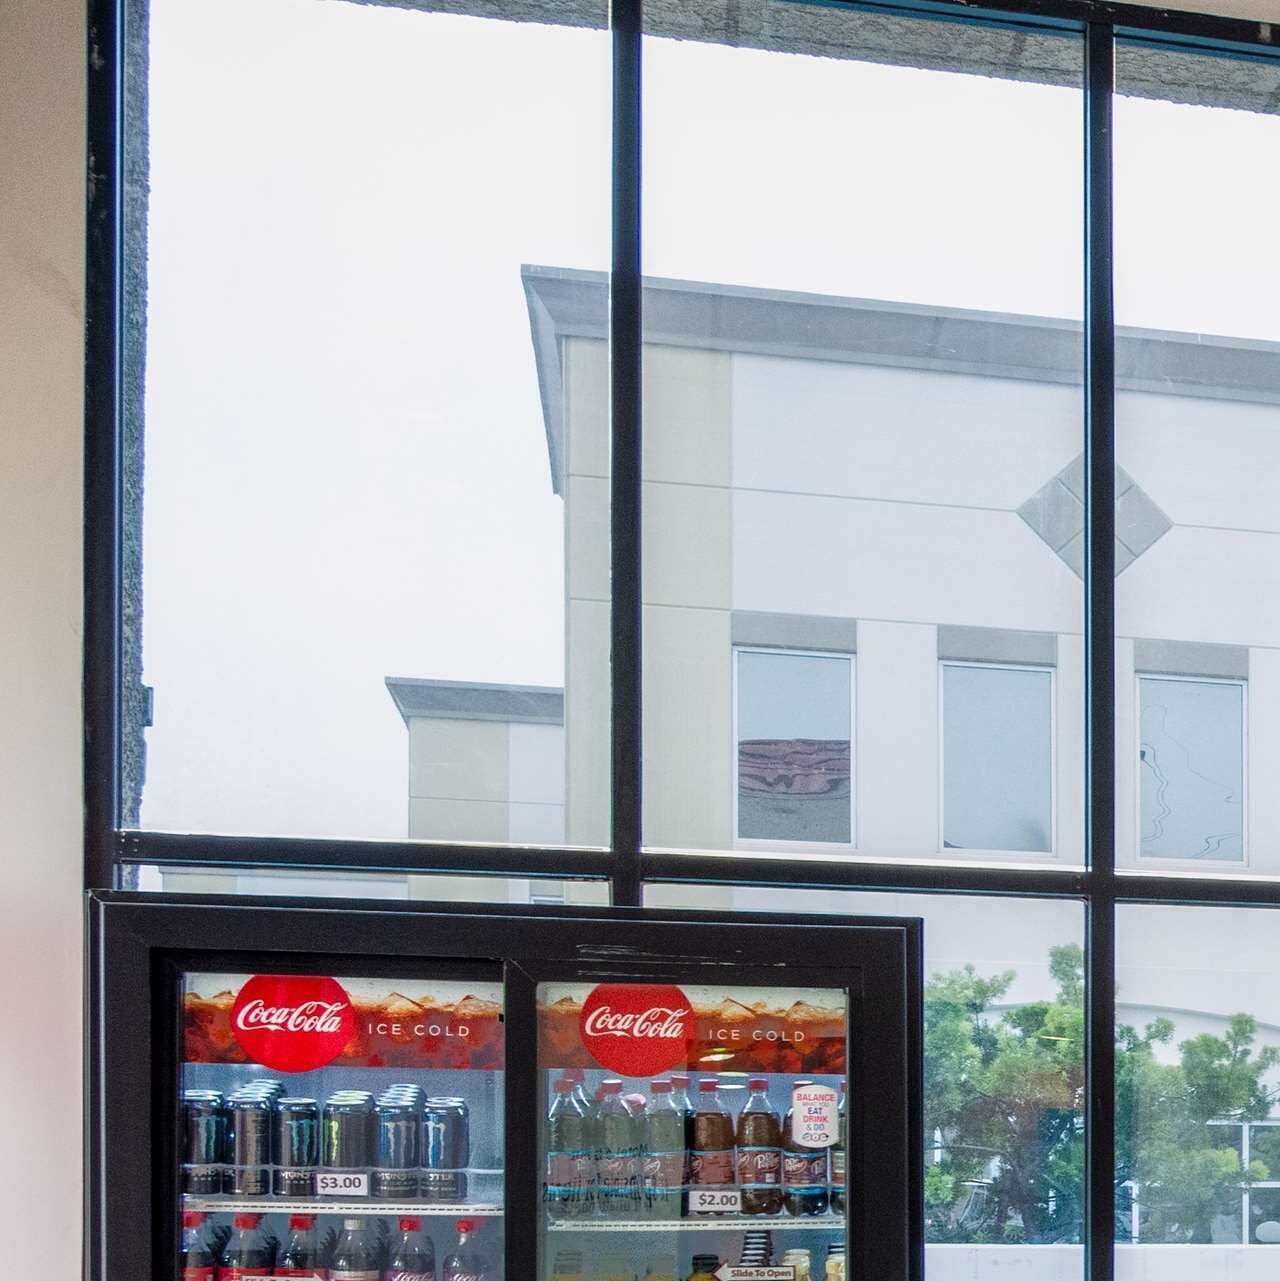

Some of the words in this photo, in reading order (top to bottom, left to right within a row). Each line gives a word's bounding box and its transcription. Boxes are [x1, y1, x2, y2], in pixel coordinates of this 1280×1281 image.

[236, 999, 349, 1033] Coca-Cola
[584, 1005, 689, 1039] Coca-Cola
[368, 1023, 402, 1035] ICE
[414, 1024, 470, 1037] COLD
[709, 1028, 740, 1041] ICE
[752, 1029, 805, 1042] COLD
[796, 1093, 835, 1102] BALANCE
[807, 1106, 822, 1115] EAT
[802, 1115, 829, 1123] DRINK
[320, 1177, 362, 1189] $3.00
[699, 1194, 738, 1206] $2.00
[731, 1268, 754, 1278] Slide
[756, 1269, 766, 1277] To
[767, 1269, 792, 1279] Open
